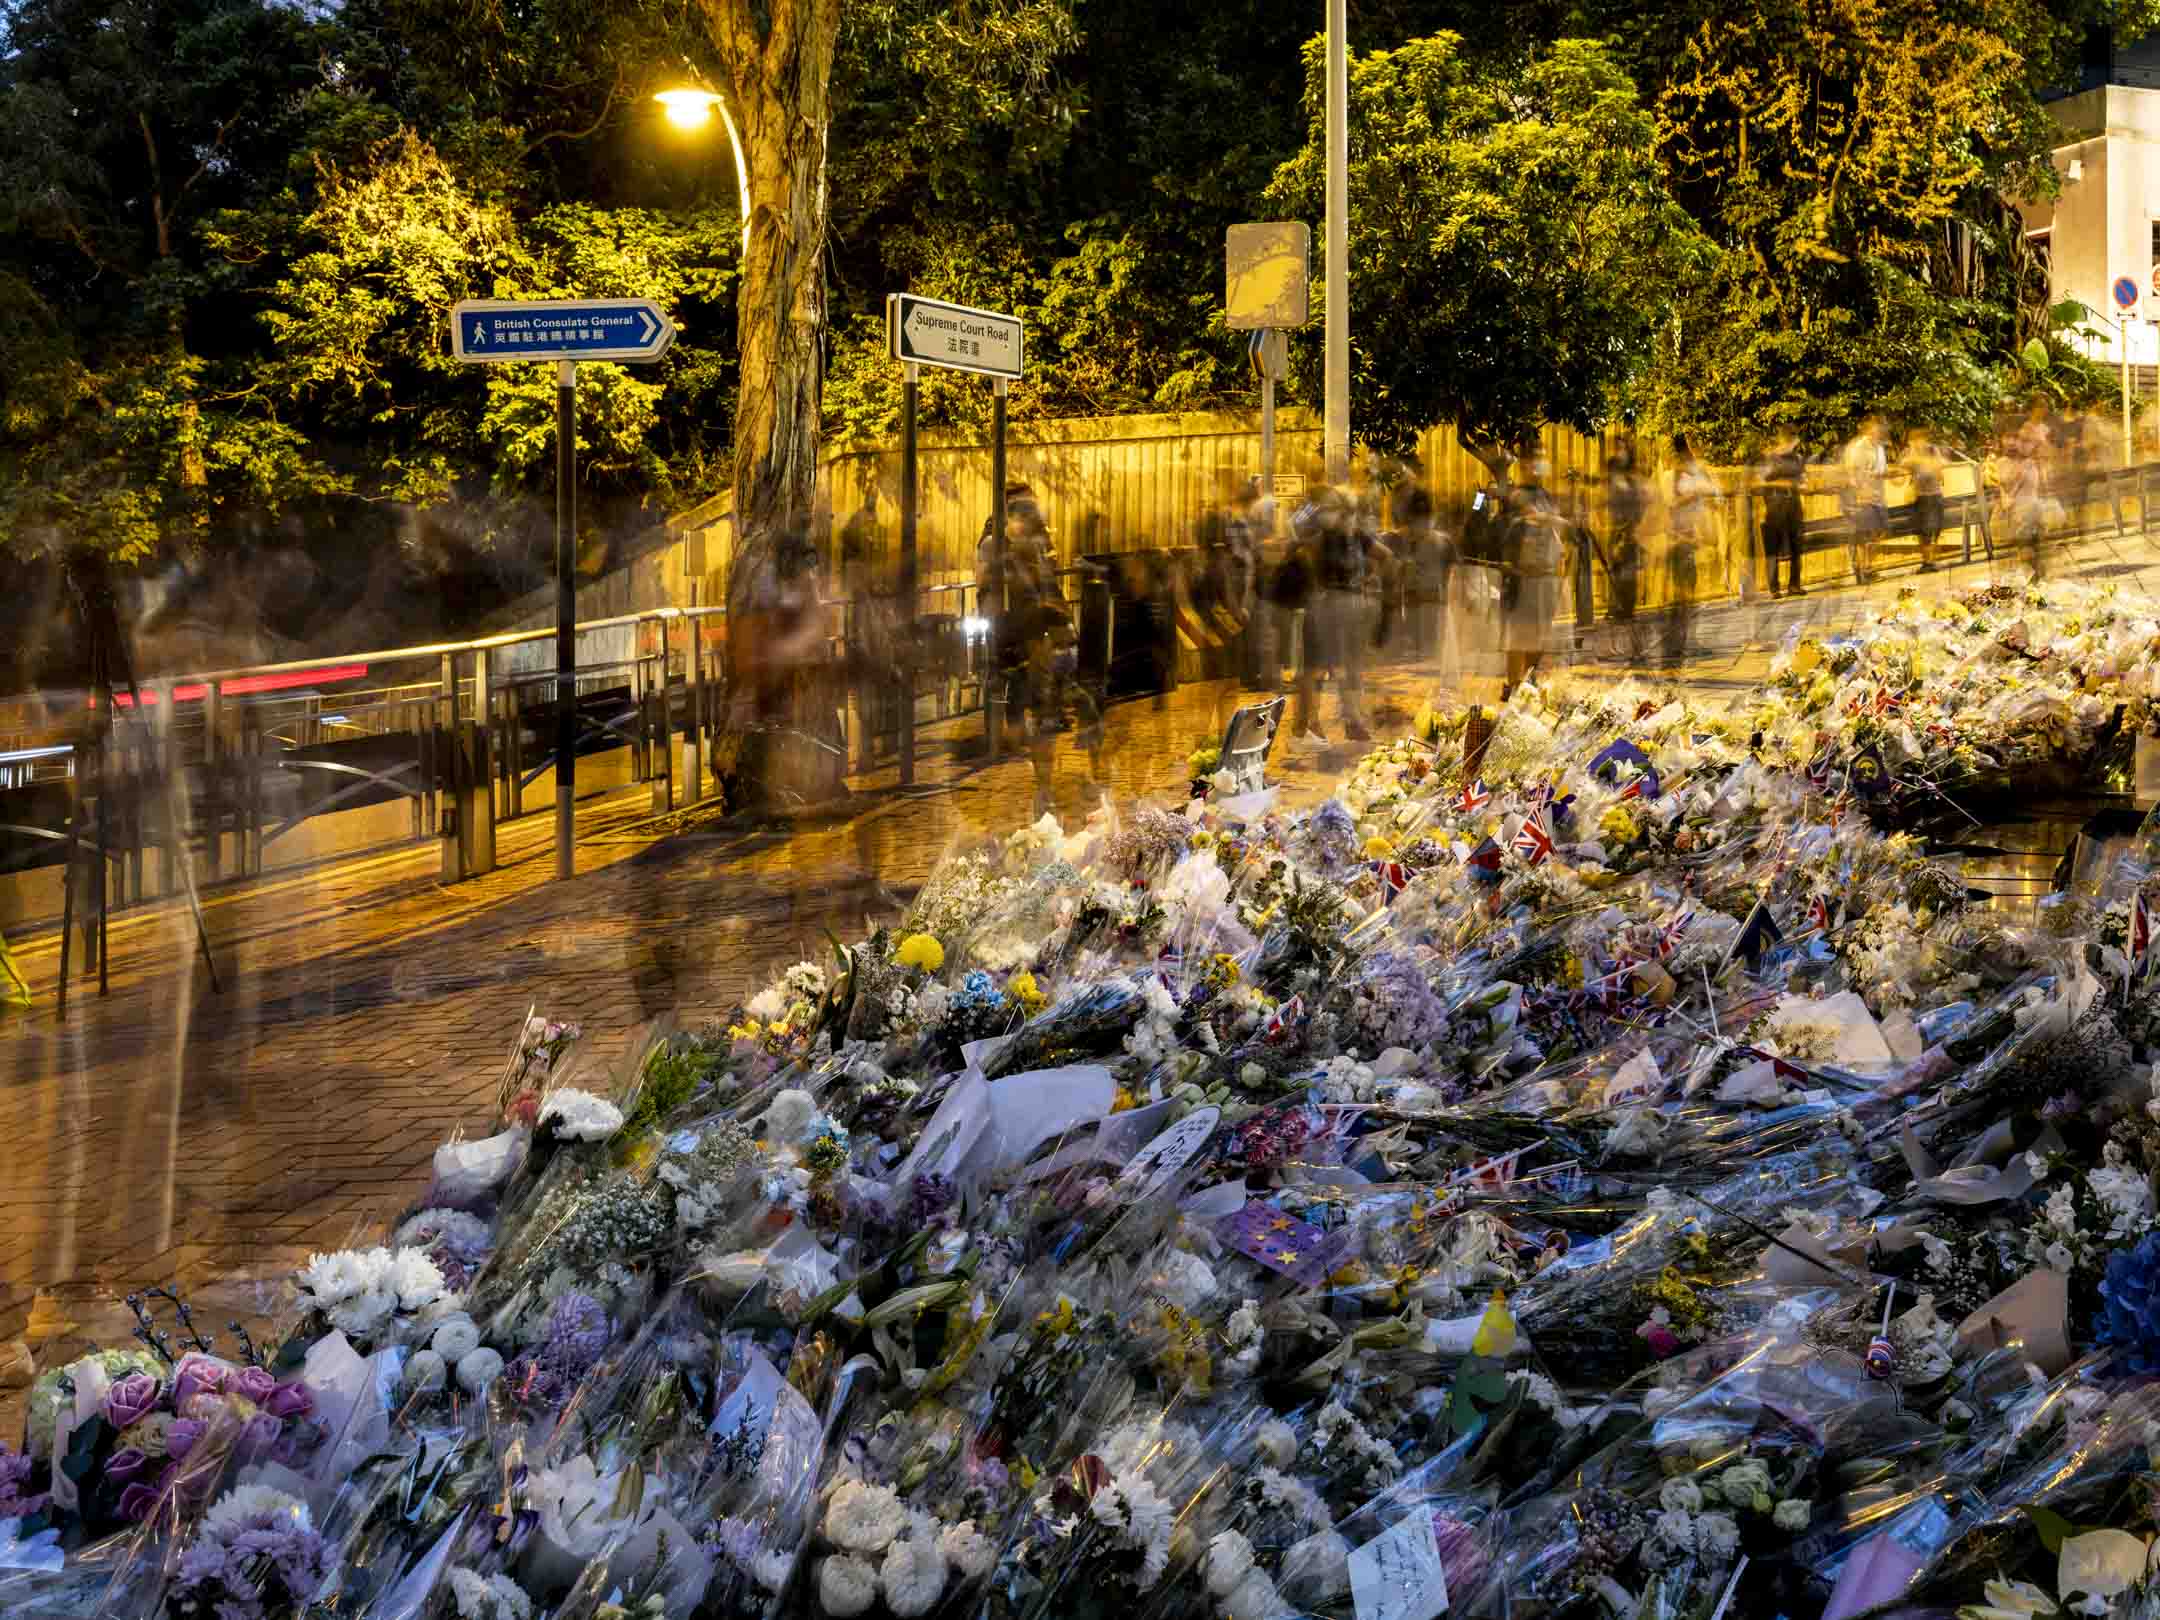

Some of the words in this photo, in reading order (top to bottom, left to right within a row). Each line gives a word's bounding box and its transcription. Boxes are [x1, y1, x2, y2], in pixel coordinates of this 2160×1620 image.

[494, 319, 531, 329] British
[533, 316, 588, 329] Consulate
[591, 315, 633, 326] General
[915, 311, 958, 332] Supreme
[960, 319, 985, 337] Court
[987, 325, 1009, 342] Road
